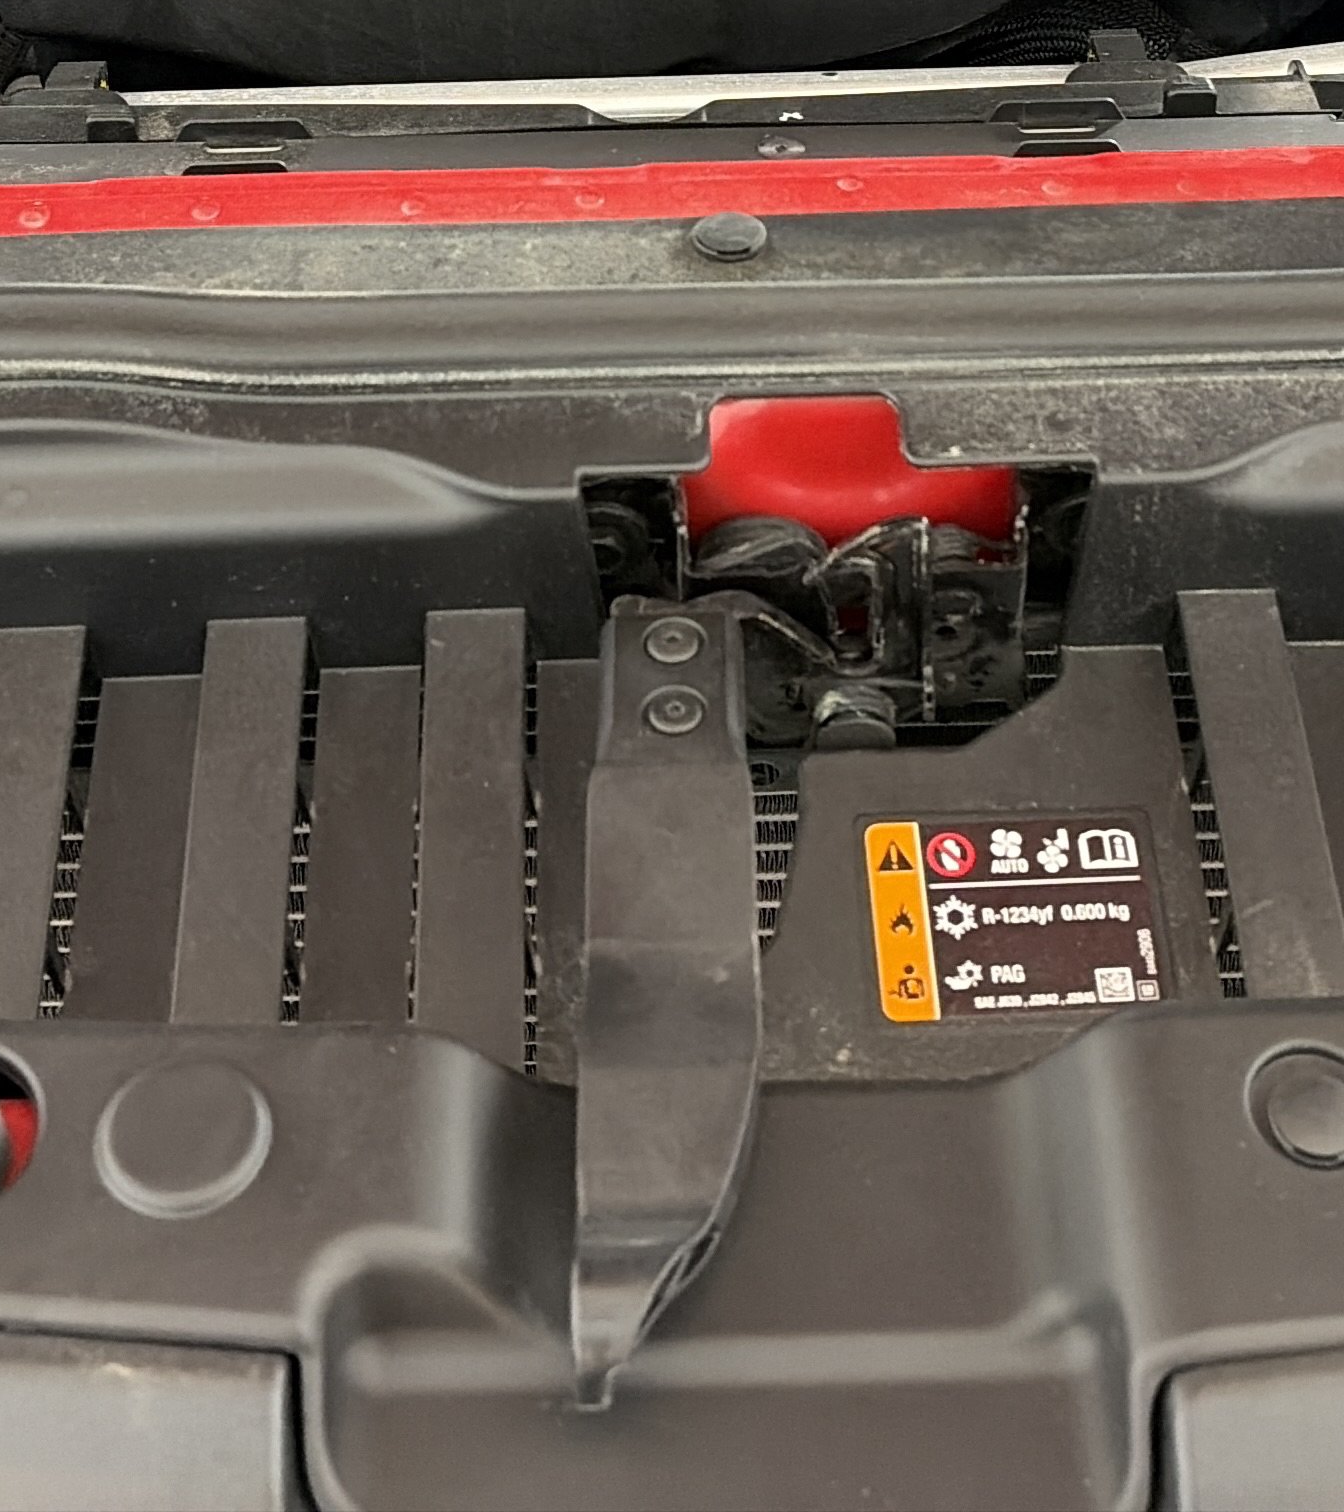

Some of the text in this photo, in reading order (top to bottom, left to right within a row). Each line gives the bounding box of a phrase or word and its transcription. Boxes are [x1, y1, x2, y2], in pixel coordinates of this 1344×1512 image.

[990, 857, 1029, 874] AUTO
[981, 902, 1131, 926] R-1234yf 0.600 kg
[990, 963, 1026, 984] PAG
